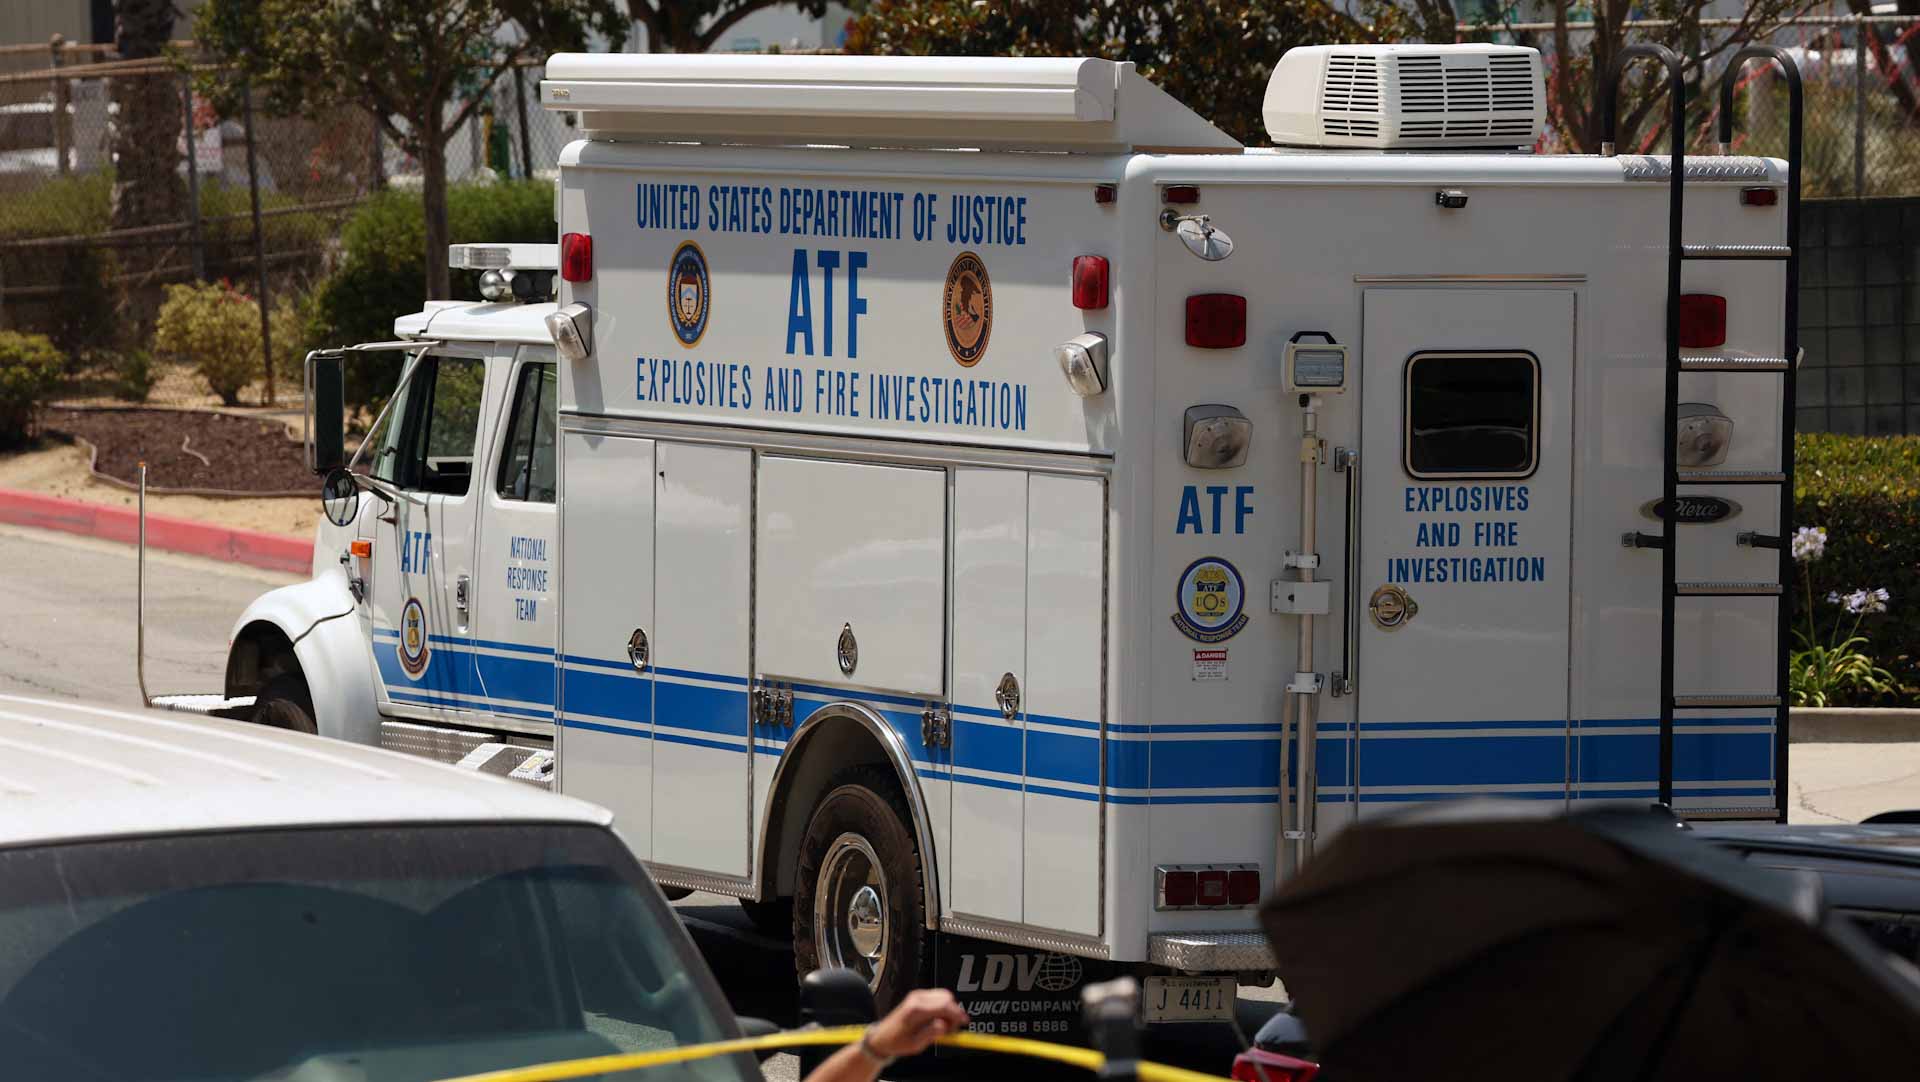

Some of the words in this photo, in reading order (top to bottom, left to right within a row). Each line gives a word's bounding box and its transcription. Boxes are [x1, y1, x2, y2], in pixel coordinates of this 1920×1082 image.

[636, 184, 700, 231] UNITED
[708, 185, 773, 234] STATES
[780, 188, 904, 241] DEPARTMENT
[914, 192, 937, 241] OF
[948, 195, 1027, 246] JUSTICE
[786, 249, 868, 359] ATF
[636, 357, 753, 410] EXPLOSIVES
[764, 367, 803, 414] AND
[816, 369, 860, 418] FIRE
[869, 373, 1028, 432] INVESTIGATION
[1176, 485, 1254, 535] ATF
[1405, 486, 1529, 513] EXPLOSIVES
[1416, 522, 1461, 547] AND
[1474, 521, 1518, 547] FIRE
[401, 530, 432, 576] ATF
[511, 536, 547, 562] NATIONAL
[507, 567, 547, 592] RESPONSE
[1387, 557, 1545, 583] INVESTIGATION
[515, 598, 537, 623] TEAM
[1173, 613, 1200, 641] NATIONAL
[1231, 615, 1248, 633] TEAM
[956, 954, 1046, 992] LDV
[967, 1001, 1010, 1016] LYNCH
[1010, 1001, 1081, 1013] COMPANY
[1156, 988, 1167, 1010] J
[1178, 988, 1223, 1010] 4411
